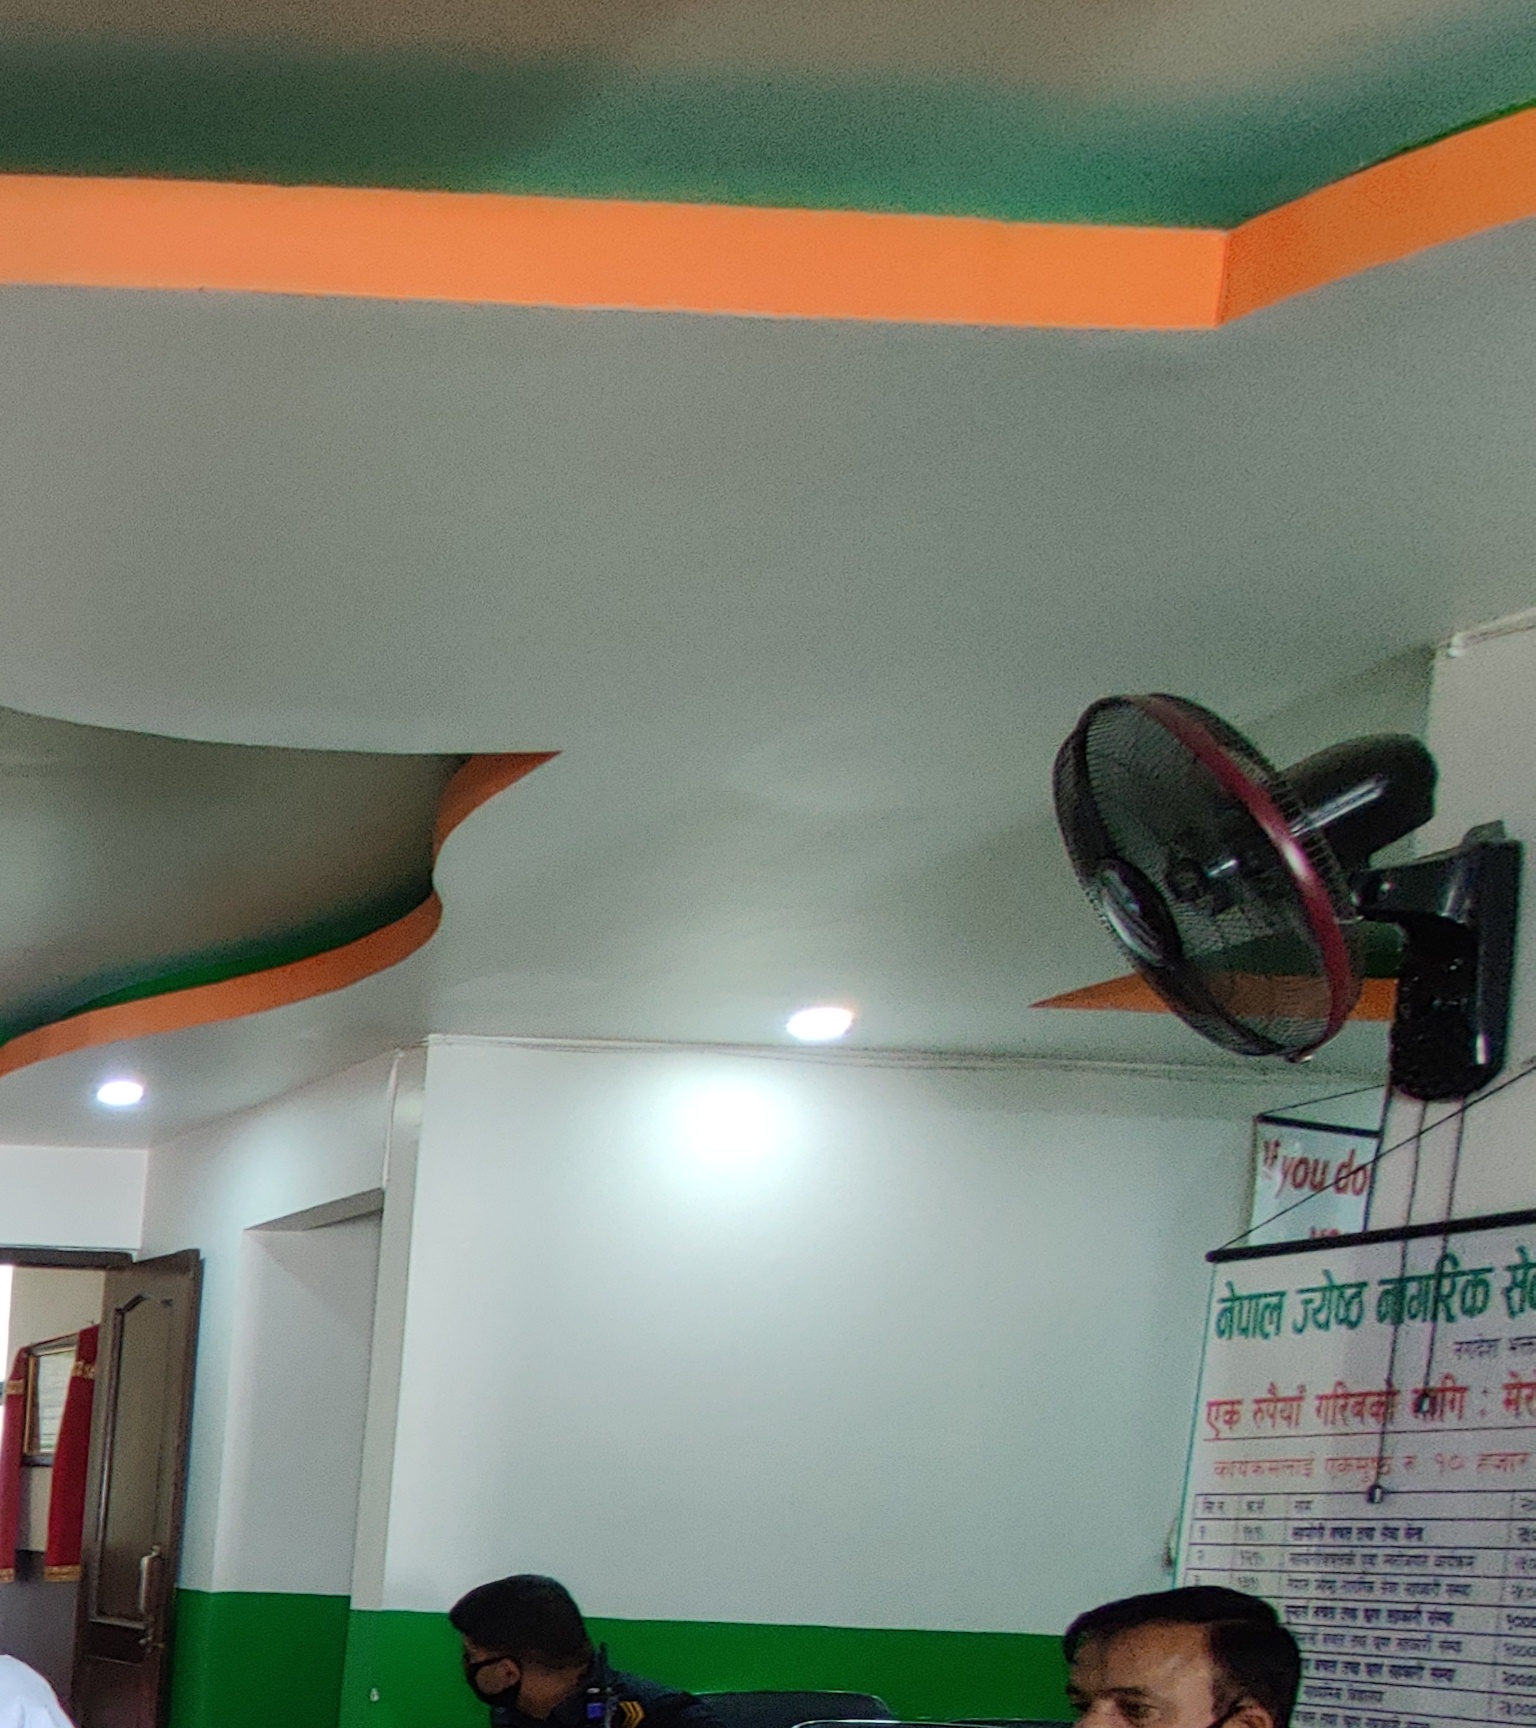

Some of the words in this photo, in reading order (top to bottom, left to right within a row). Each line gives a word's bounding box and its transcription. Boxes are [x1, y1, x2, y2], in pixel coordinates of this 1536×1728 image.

[1275, 1155, 1330, 1198] you
[1333, 1148, 1370, 1196] do
[1216, 1281, 1287, 1341] नेपाल
[1376, 1253, 1495, 1325] नागरिक
[1206, 1399, 1244, 1441] एक
